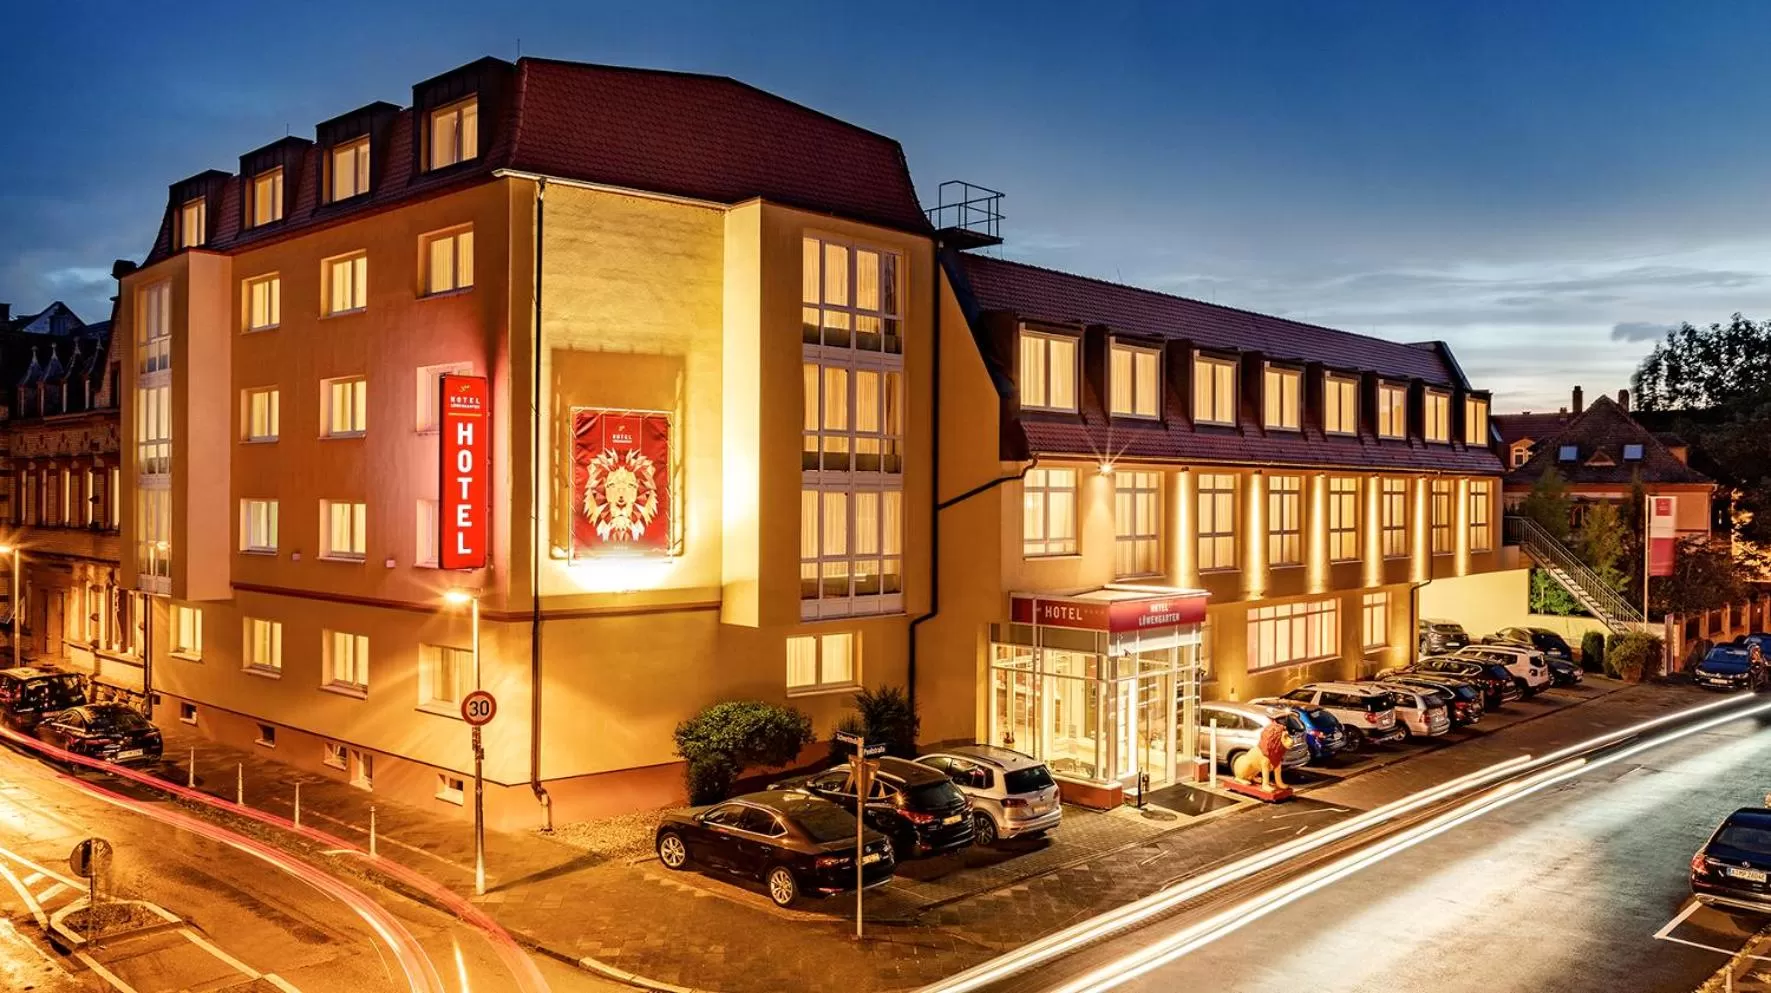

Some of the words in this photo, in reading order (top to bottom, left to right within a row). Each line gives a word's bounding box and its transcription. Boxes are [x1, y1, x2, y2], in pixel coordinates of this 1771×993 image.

[450, 396, 480, 404] HOTEL
[457, 422, 473, 554] HOTEL
[1045, 605, 1083, 620] HOTEL
[469, 700, 490, 717] 30
